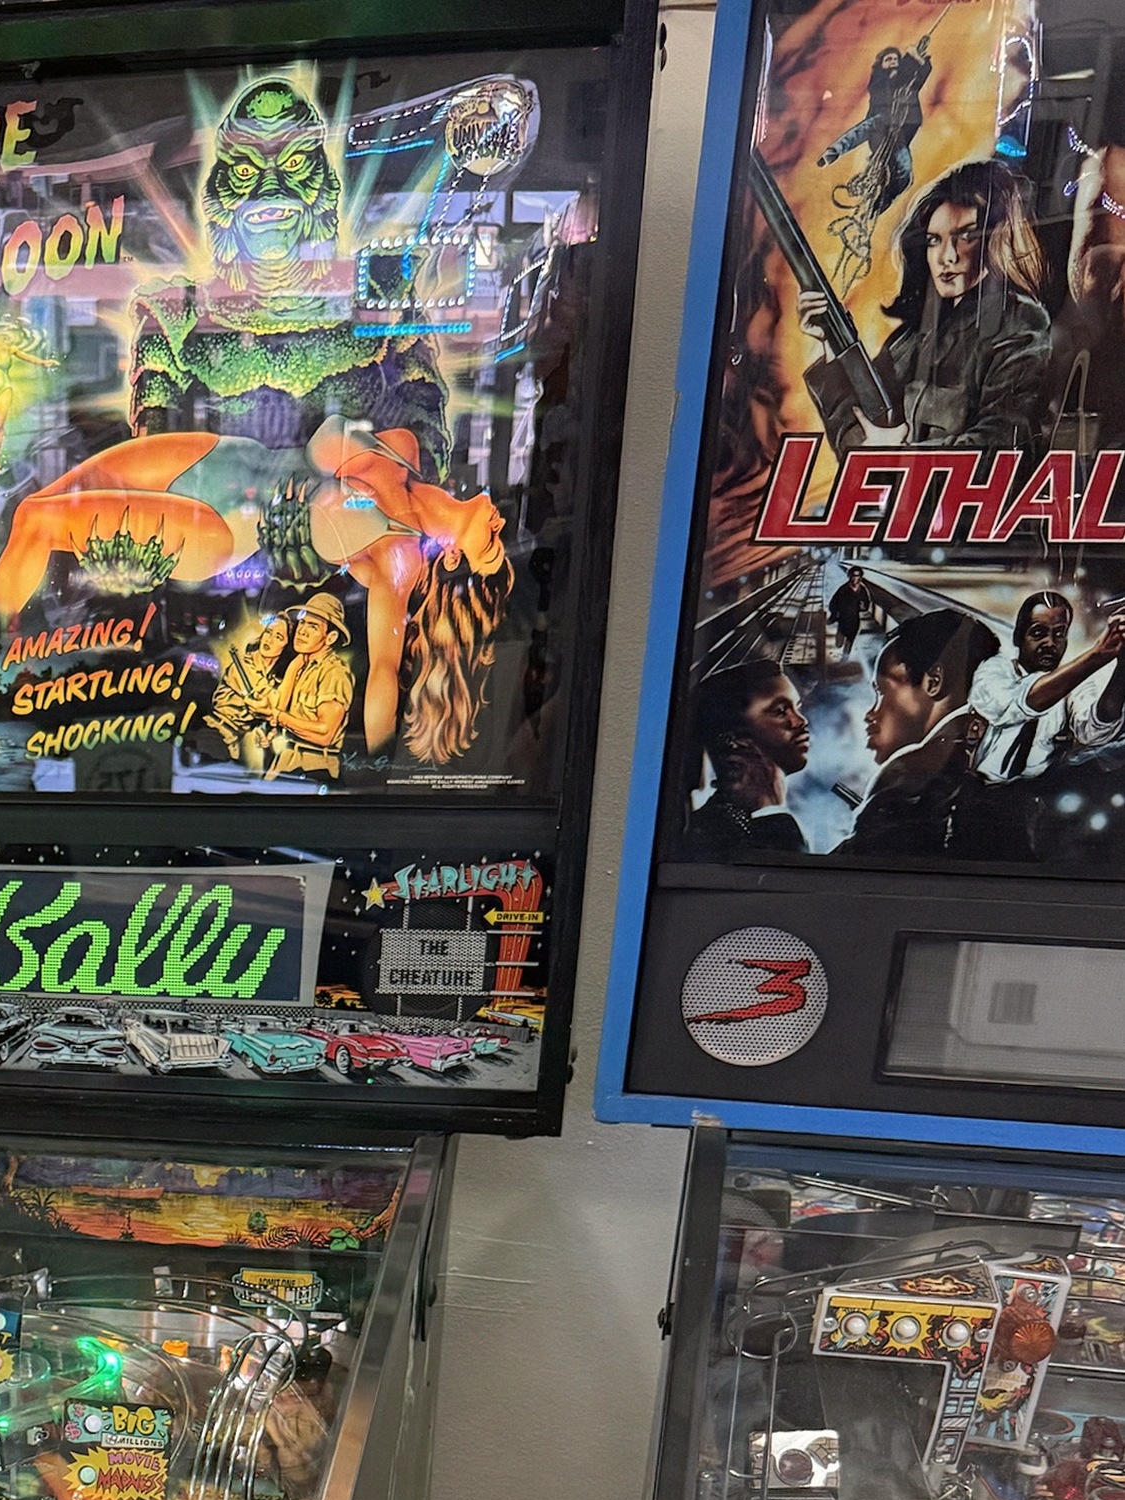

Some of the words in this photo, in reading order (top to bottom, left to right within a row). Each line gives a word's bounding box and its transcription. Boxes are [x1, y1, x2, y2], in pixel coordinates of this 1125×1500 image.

[756, 433, 1125, 544] LETHAL
[2, 604, 155, 671] AMAZING!
[12, 656, 197, 718] STARTLING!
[25, 703, 197, 761] SHOCKING!
[392, 859, 537, 900] STARLIGHT
[496, 913, 539, 922] DRIVE-IN
[420, 939, 450, 956] THE
[389, 968, 475, 986] CREATURE
[684, 959, 812, 1025] 3
[112, 1405, 156, 1435] BIG
[108, 1451, 161, 1472] MOVIE
[96, 1466, 166, 1494] MADNESS
